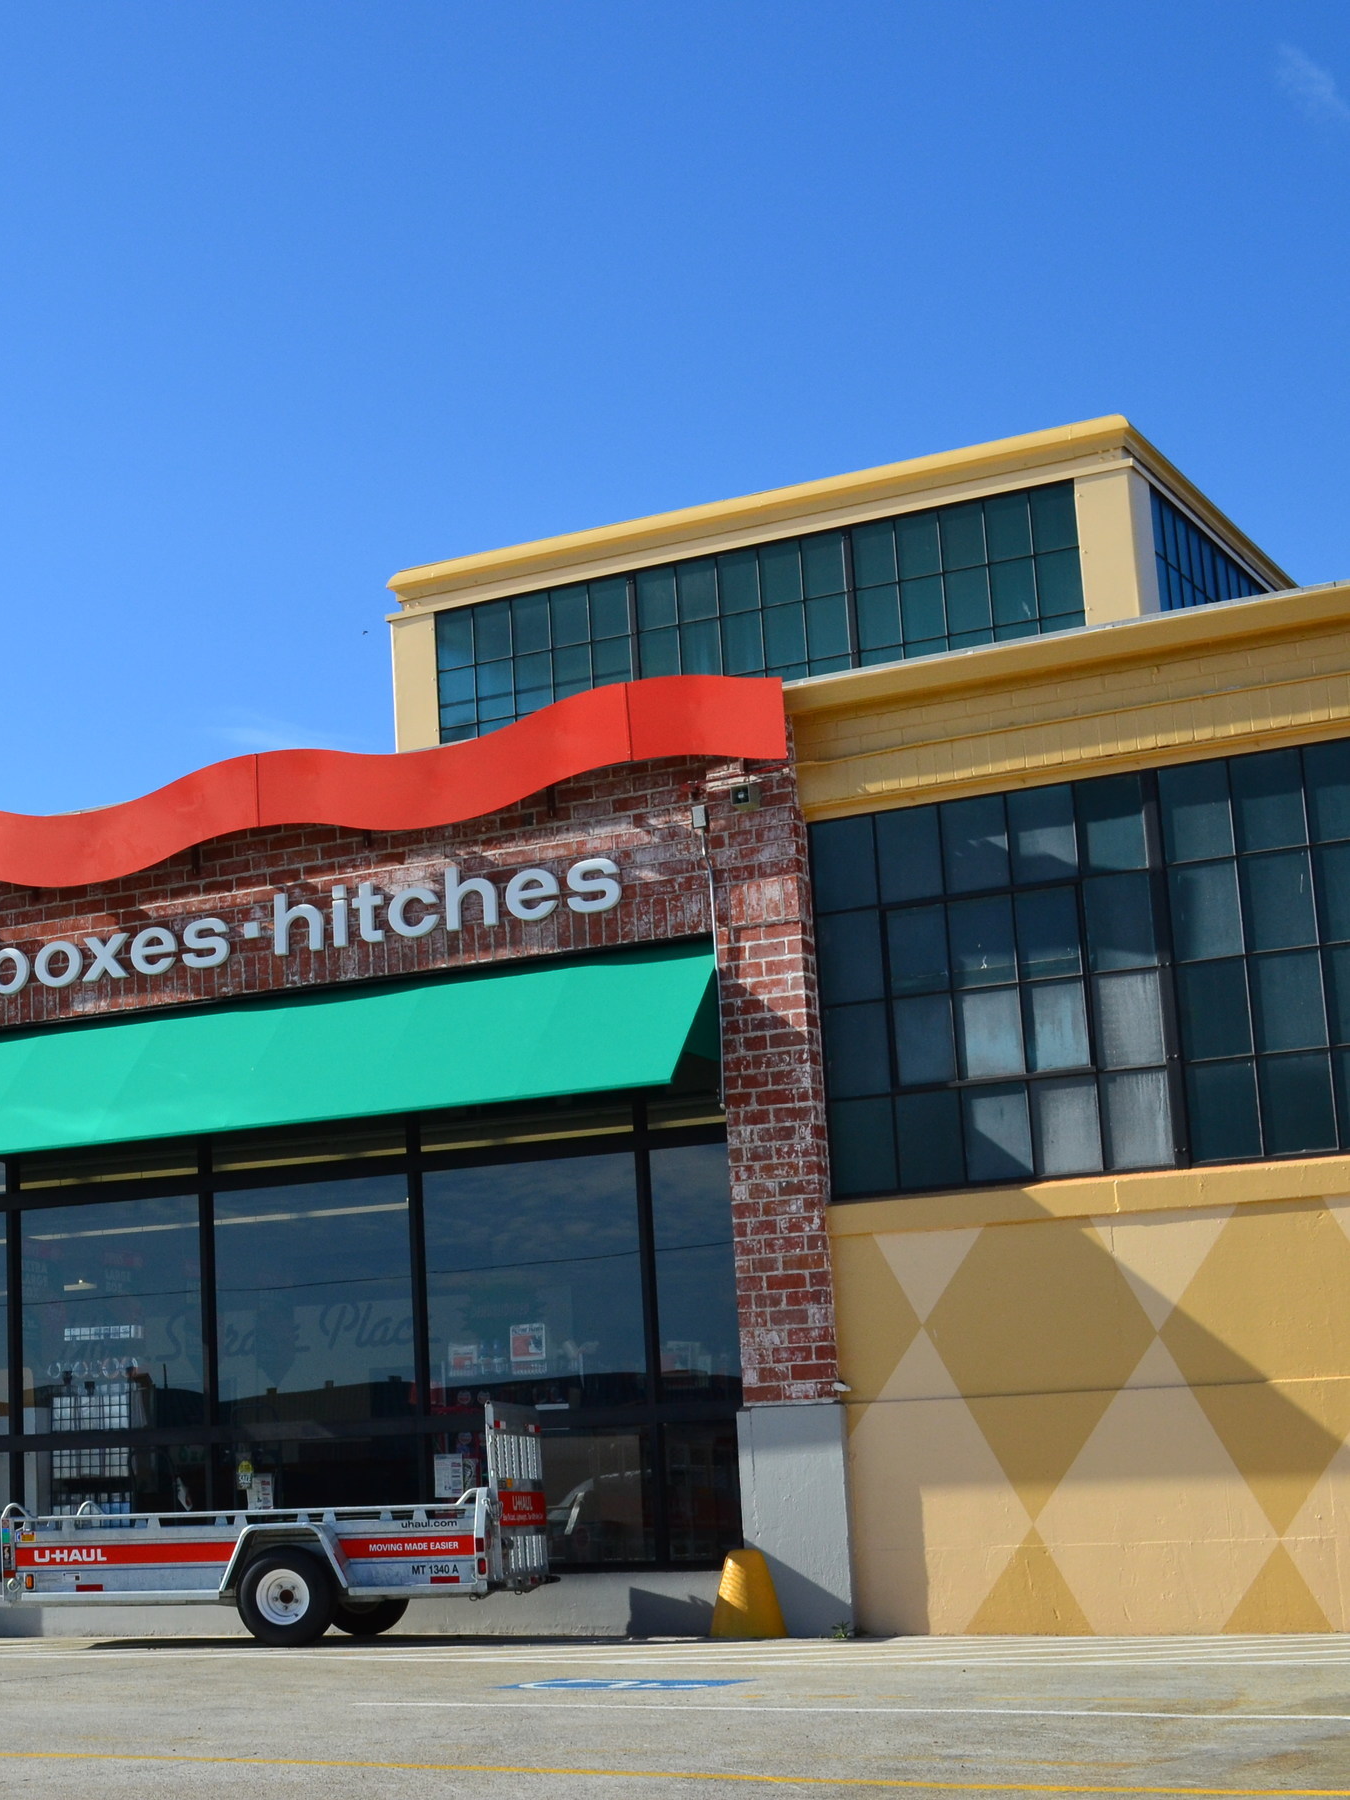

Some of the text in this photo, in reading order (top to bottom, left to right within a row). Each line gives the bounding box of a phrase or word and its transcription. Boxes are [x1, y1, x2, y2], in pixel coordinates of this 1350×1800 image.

[401, 1519, 458, 1529] uhaul.com
[369, 1541, 459, 1552] MOVING MADE EASIER
[34, 1548, 107, 1563] U-HAUL
[411, 1564, 459, 1575] MT 1340 A
